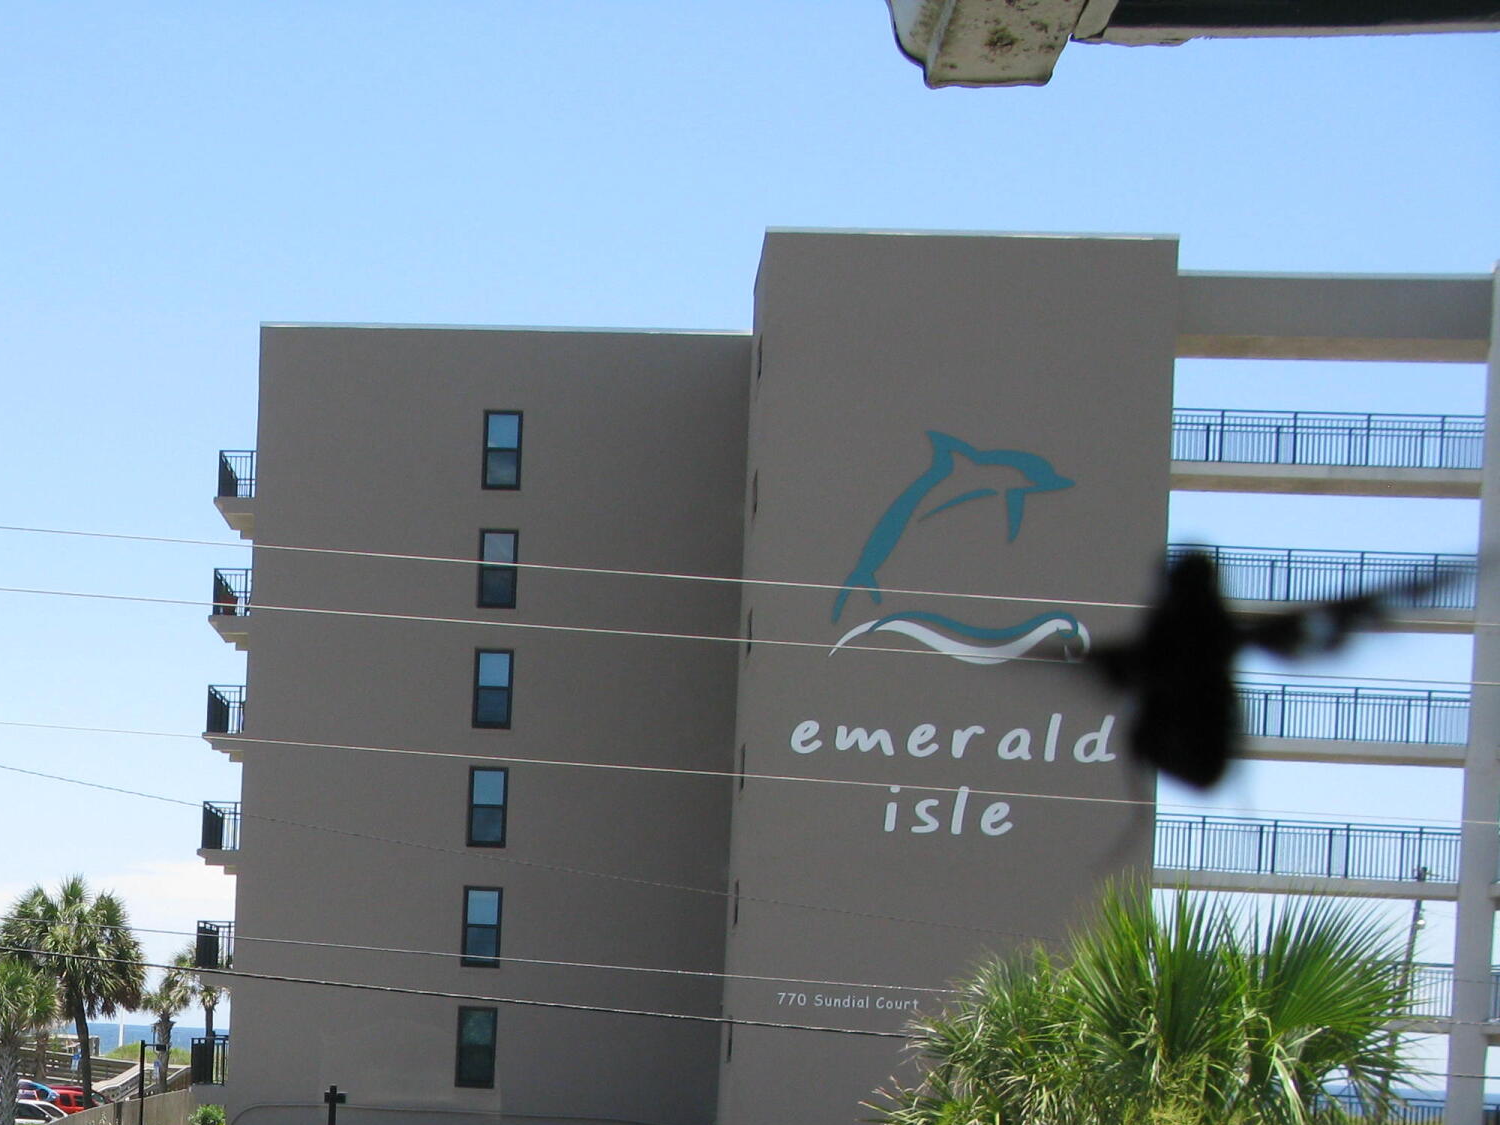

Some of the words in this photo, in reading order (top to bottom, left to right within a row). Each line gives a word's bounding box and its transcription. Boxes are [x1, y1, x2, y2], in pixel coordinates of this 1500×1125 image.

[790, 713, 1117, 763] emerald
[883, 785, 1014, 836] isle
[777, 992, 807, 1006] 770
[813, 994, 870, 1009] Sundial
[875, 996, 919, 1010] Court
